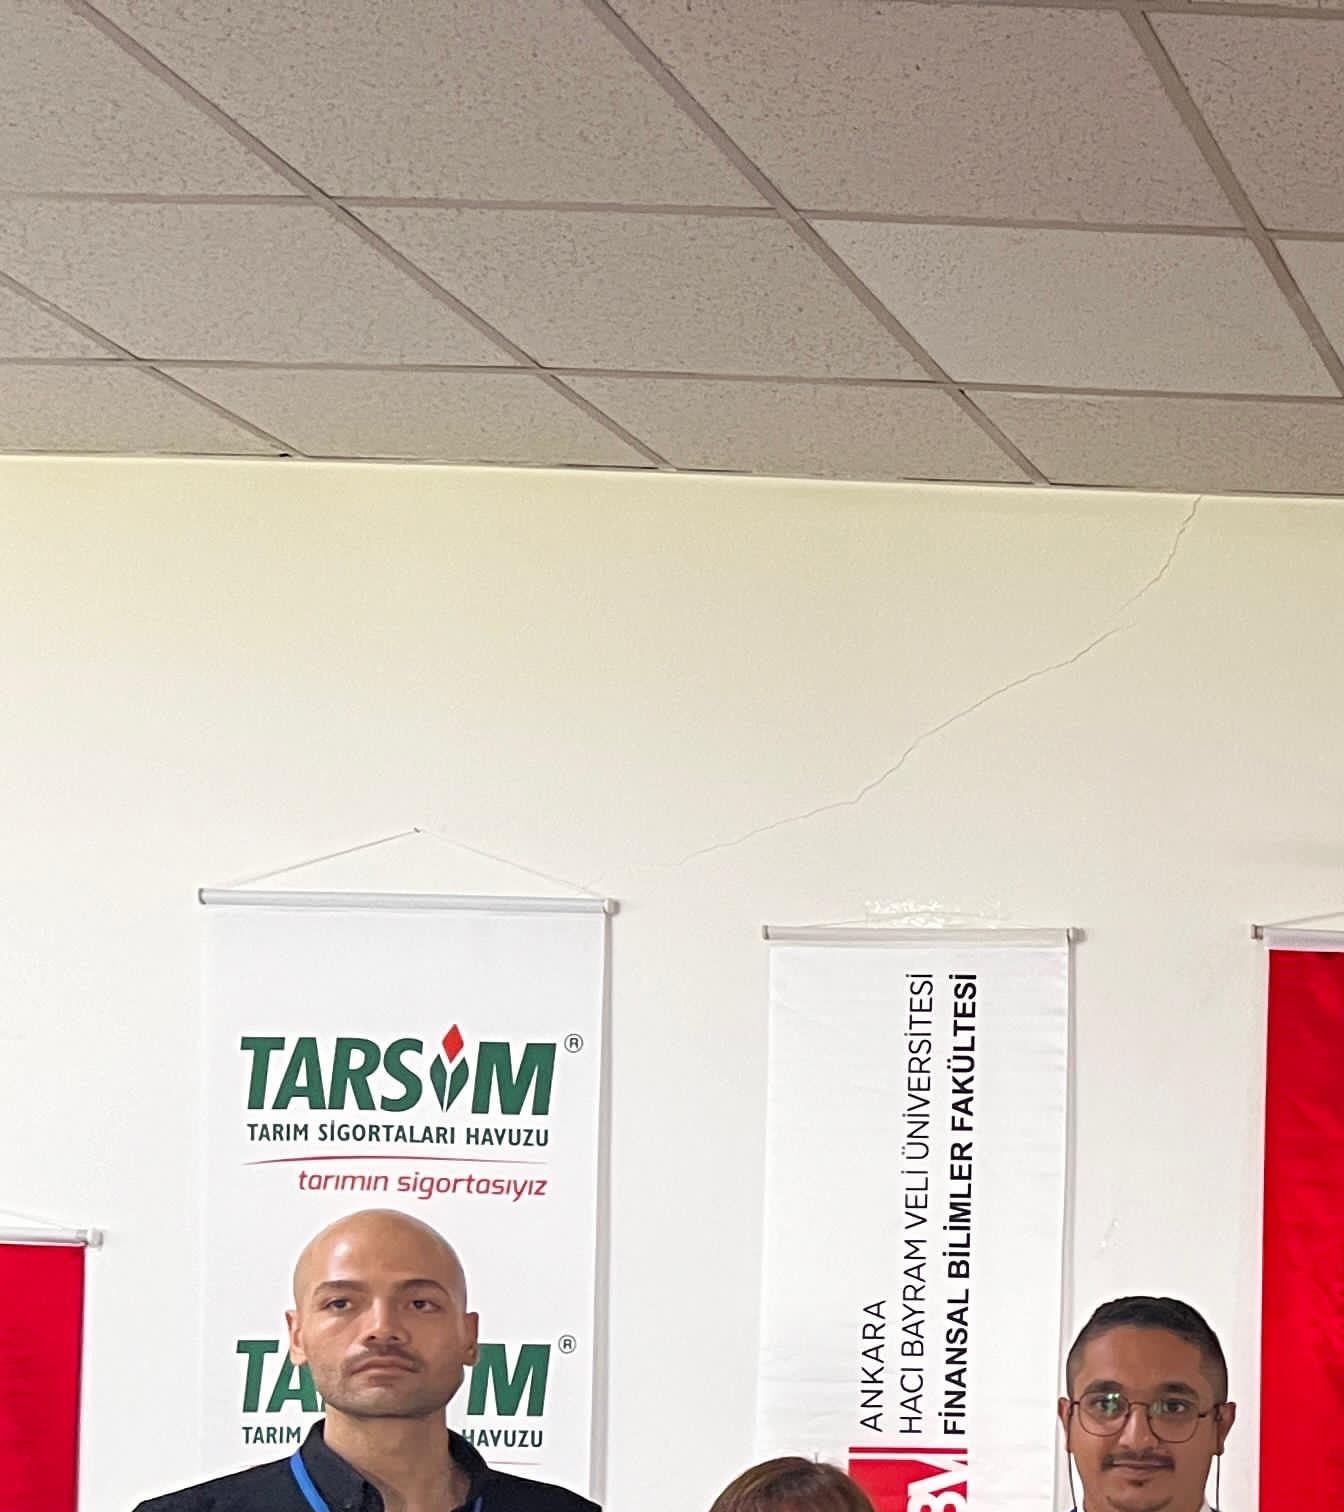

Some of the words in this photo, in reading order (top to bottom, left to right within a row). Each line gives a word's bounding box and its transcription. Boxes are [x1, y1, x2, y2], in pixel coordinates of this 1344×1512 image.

[901, 973, 934, 1160] ÜNİVERSİTESİ
[946, 973, 977, 1132] FAKÜLTESİ
[246, 1122, 309, 1142] TARIM
[317, 1119, 456, 1144] SİGORTALARI
[465, 1126, 549, 1147] HAVUZU
[900, 1170, 929, 1230] VELİ
[942, 1141, 973, 1279] BİLİMLER
[900, 1239, 928, 1356] BAYRAM
[859, 1300, 887, 1432] ANKARA
[899, 1367, 925, 1434] HACI
[938, 1288, 970, 1435] FİNANSAL
[242, 1426, 301, 1445] TARIM
